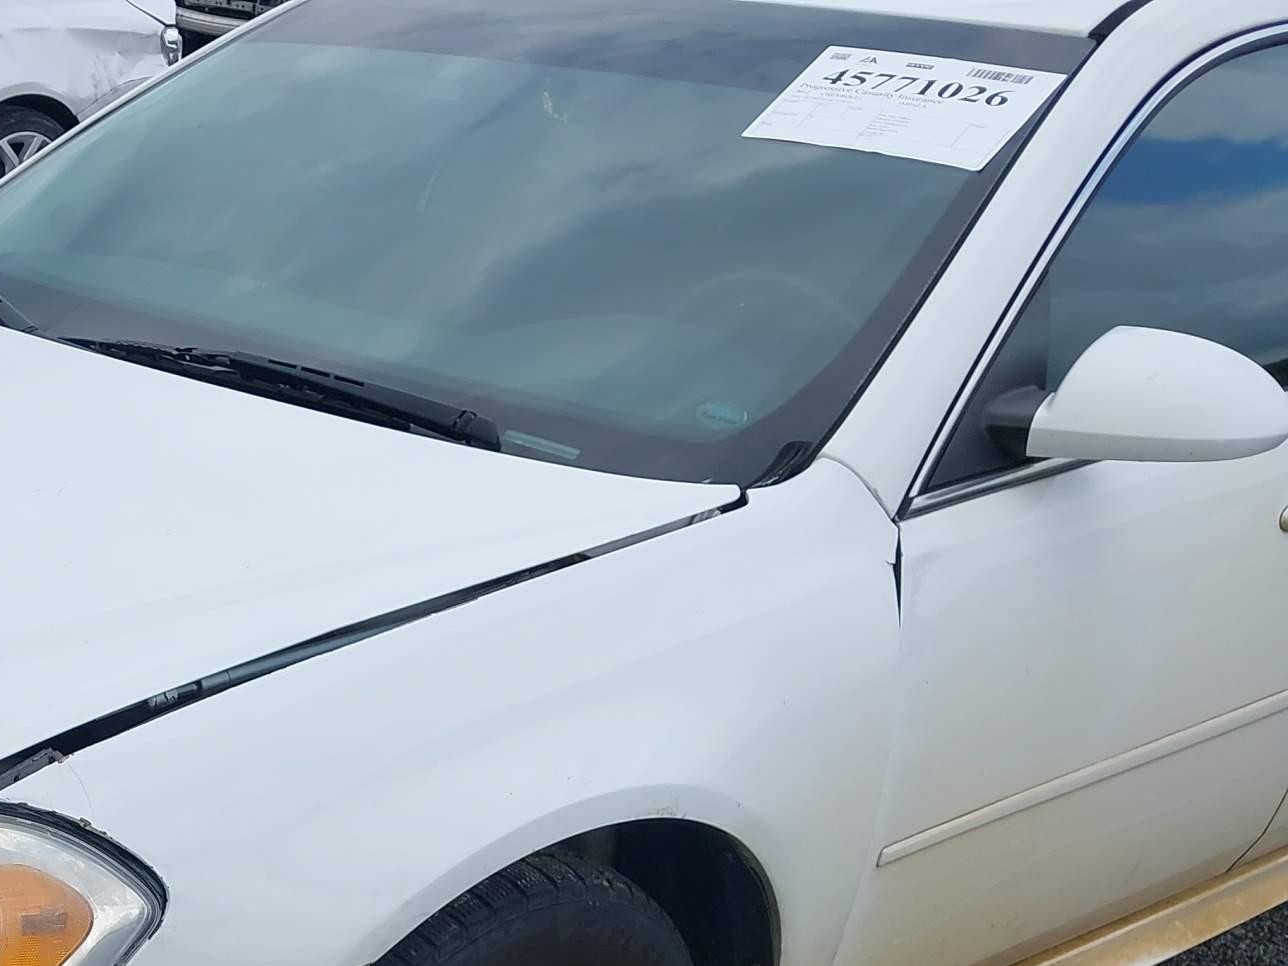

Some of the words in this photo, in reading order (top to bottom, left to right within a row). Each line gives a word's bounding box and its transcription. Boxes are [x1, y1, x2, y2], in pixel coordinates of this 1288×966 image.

[799, 82, 854, 94] Progressive
[897, 94, 945, 104] Insurance
[823, 69, 1016, 107] 45771026
